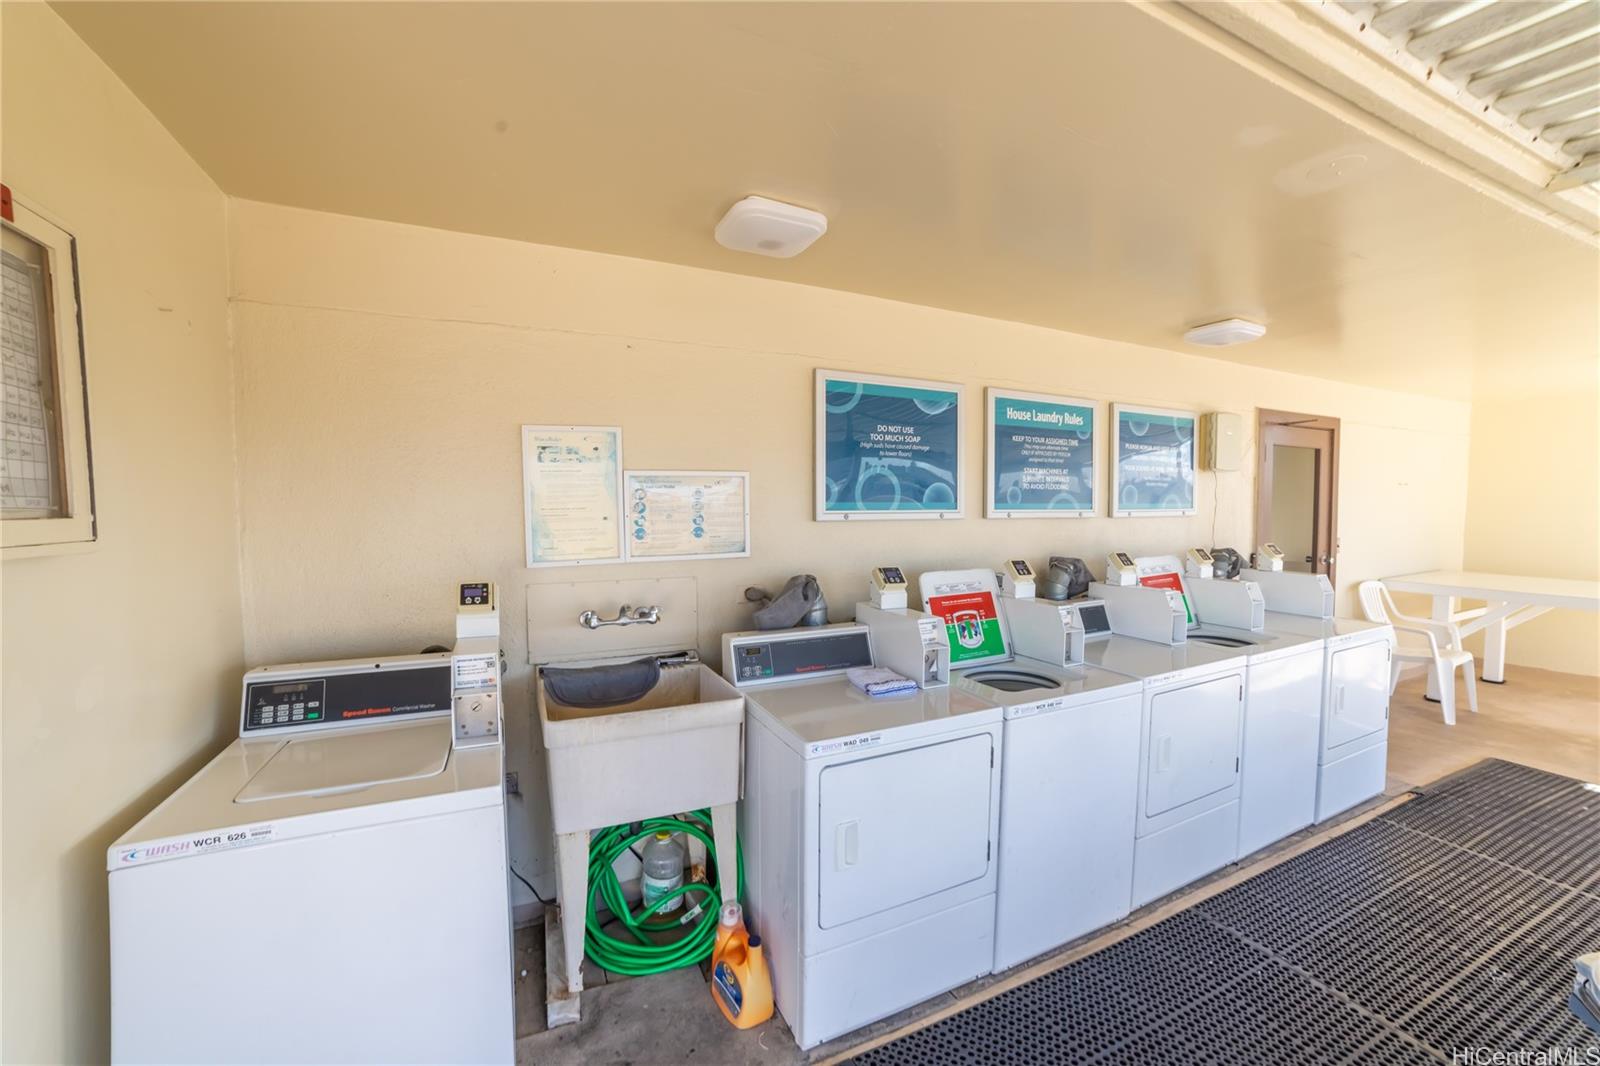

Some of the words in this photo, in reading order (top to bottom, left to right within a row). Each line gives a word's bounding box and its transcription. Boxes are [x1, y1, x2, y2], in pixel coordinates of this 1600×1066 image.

[1006, 407, 1031, 421] House
[1032, 409, 1063, 426] Laundry
[1064, 412, 1084, 425] Rules
[889, 425, 901, 433] NOT
[902, 426, 914, 434] USE
[870, 433, 883, 441] TOO
[884, 434, 904, 442] MUCH
[905, 435, 921, 443] SOAP
[1032, 436, 1045, 444] YOUR
[193, 836, 222, 848] WCR
[227, 831, 247, 842] 626
